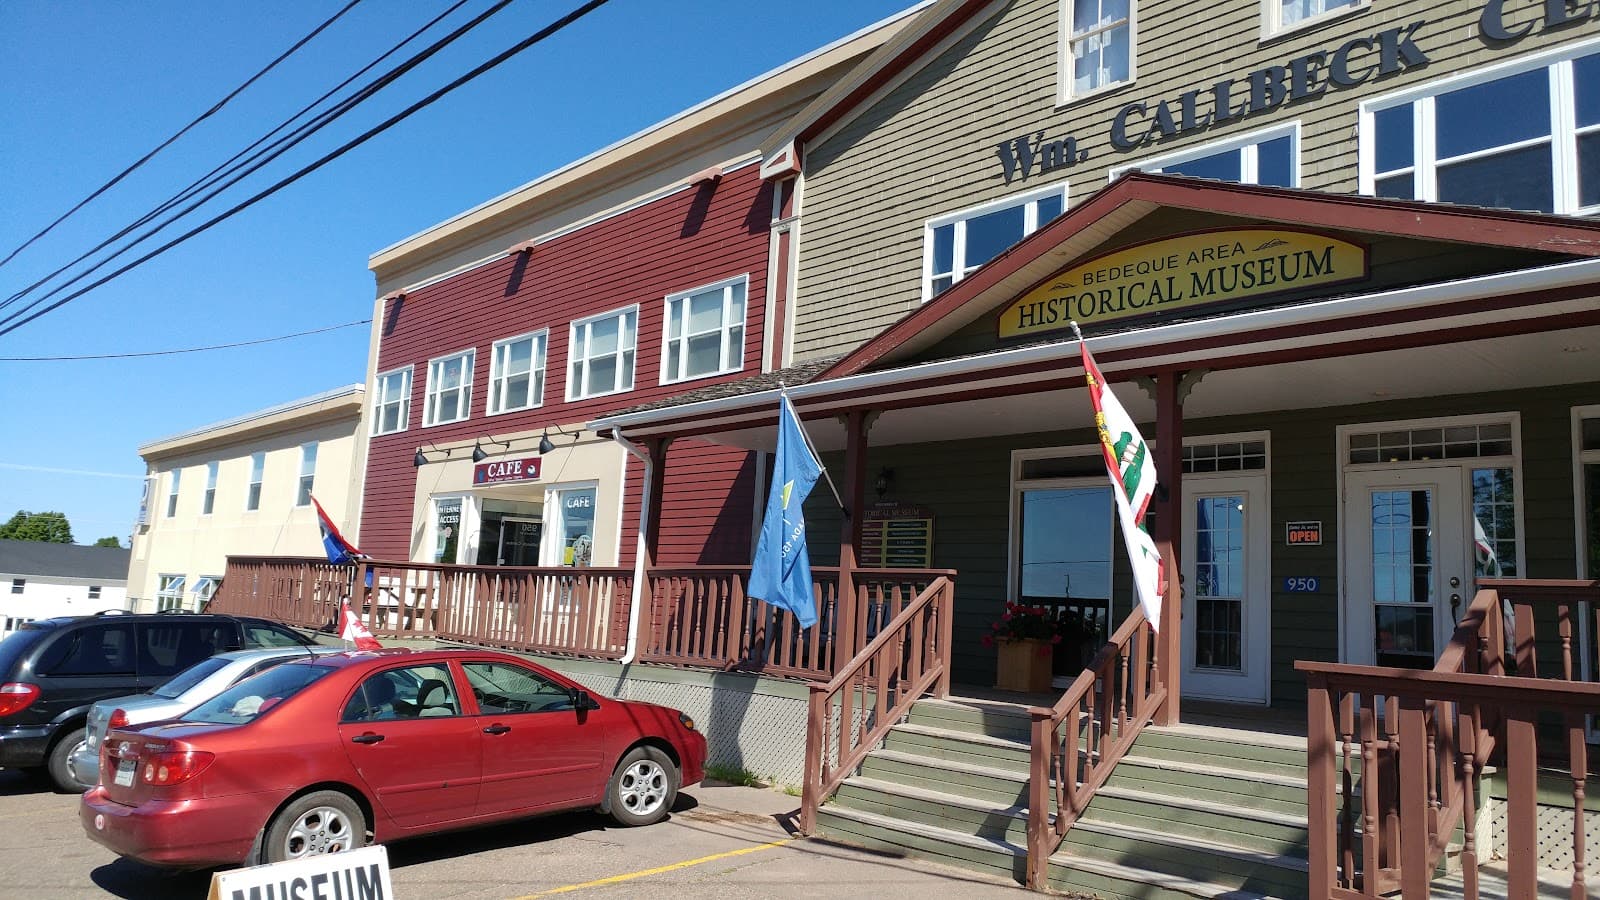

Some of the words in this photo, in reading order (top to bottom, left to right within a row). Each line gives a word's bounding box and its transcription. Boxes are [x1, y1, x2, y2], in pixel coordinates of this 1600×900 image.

[995, 131, 1089, 187] Wm.
[1110, 20, 1430, 153] CALLBECK
[1478, 0, 1600, 41] CE
[1082, 254, 1179, 286] BEDEQUE
[1186, 241, 1246, 266] AREA
[1017, 275, 1183, 329] HISTORICAL
[1189, 245, 1336, 299] MUSEUM
[487, 460, 522, 478] CAFE
[567, 495, 590, 508] CAFE
[439, 514, 460, 524] ACCESS
[1289, 530, 1319, 543] OPEN
[1287, 578, 1317, 592] 950
